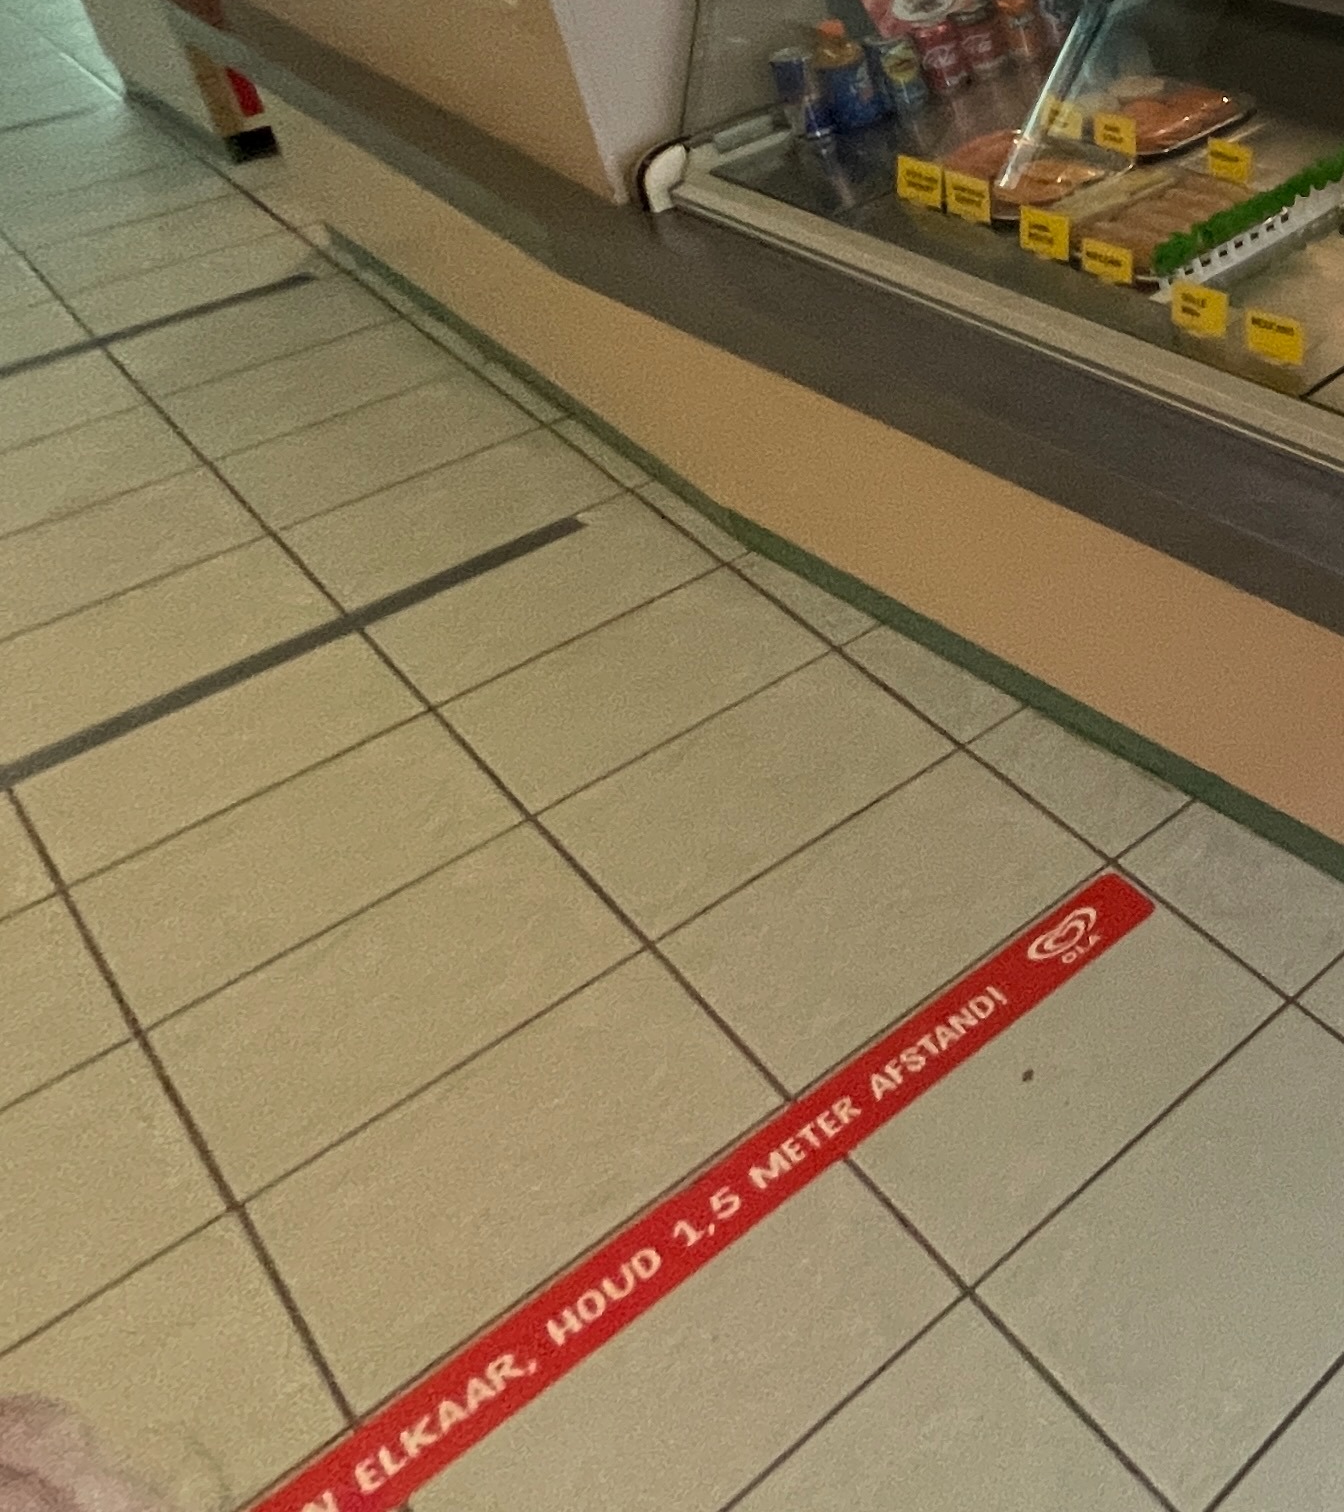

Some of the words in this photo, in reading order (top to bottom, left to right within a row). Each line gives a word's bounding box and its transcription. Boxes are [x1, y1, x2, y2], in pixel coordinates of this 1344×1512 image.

[1061, 934, 1101, 964] OLA
[354, 1353, 538, 1496] ELKAAR,
[546, 1246, 662, 1347] HOUD
[672, 1185, 742, 1247] 1,5
[748, 1095, 862, 1189] METER
[870, 985, 1009, 1102] AFSTAND!
